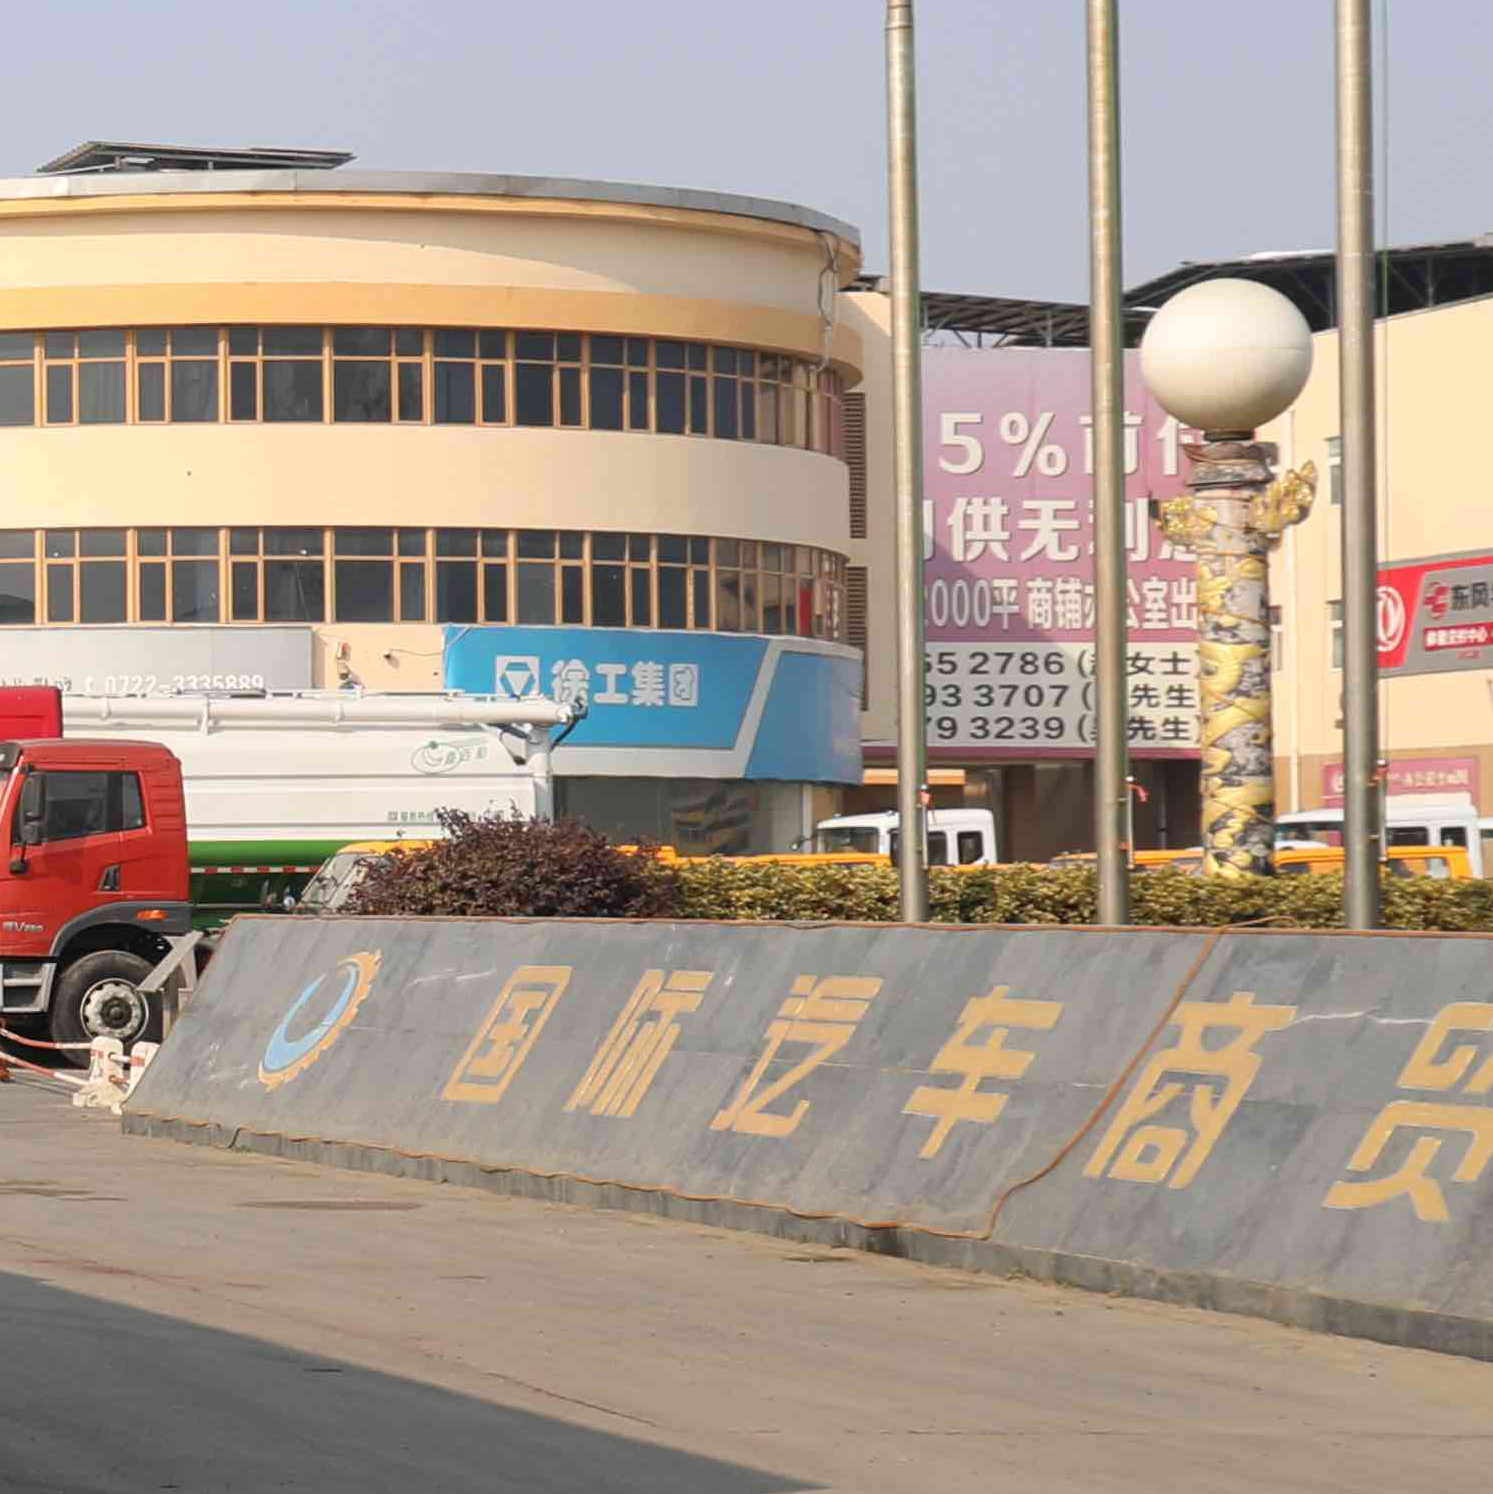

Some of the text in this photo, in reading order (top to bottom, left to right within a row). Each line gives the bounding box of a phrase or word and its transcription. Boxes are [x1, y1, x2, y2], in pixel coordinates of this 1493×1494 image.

[969, 651, 1064, 676] 2786
[550, 659, 698, 707] 徐工集团
[973, 684, 1069, 707] 3707
[969, 716, 1064, 739] 3239
